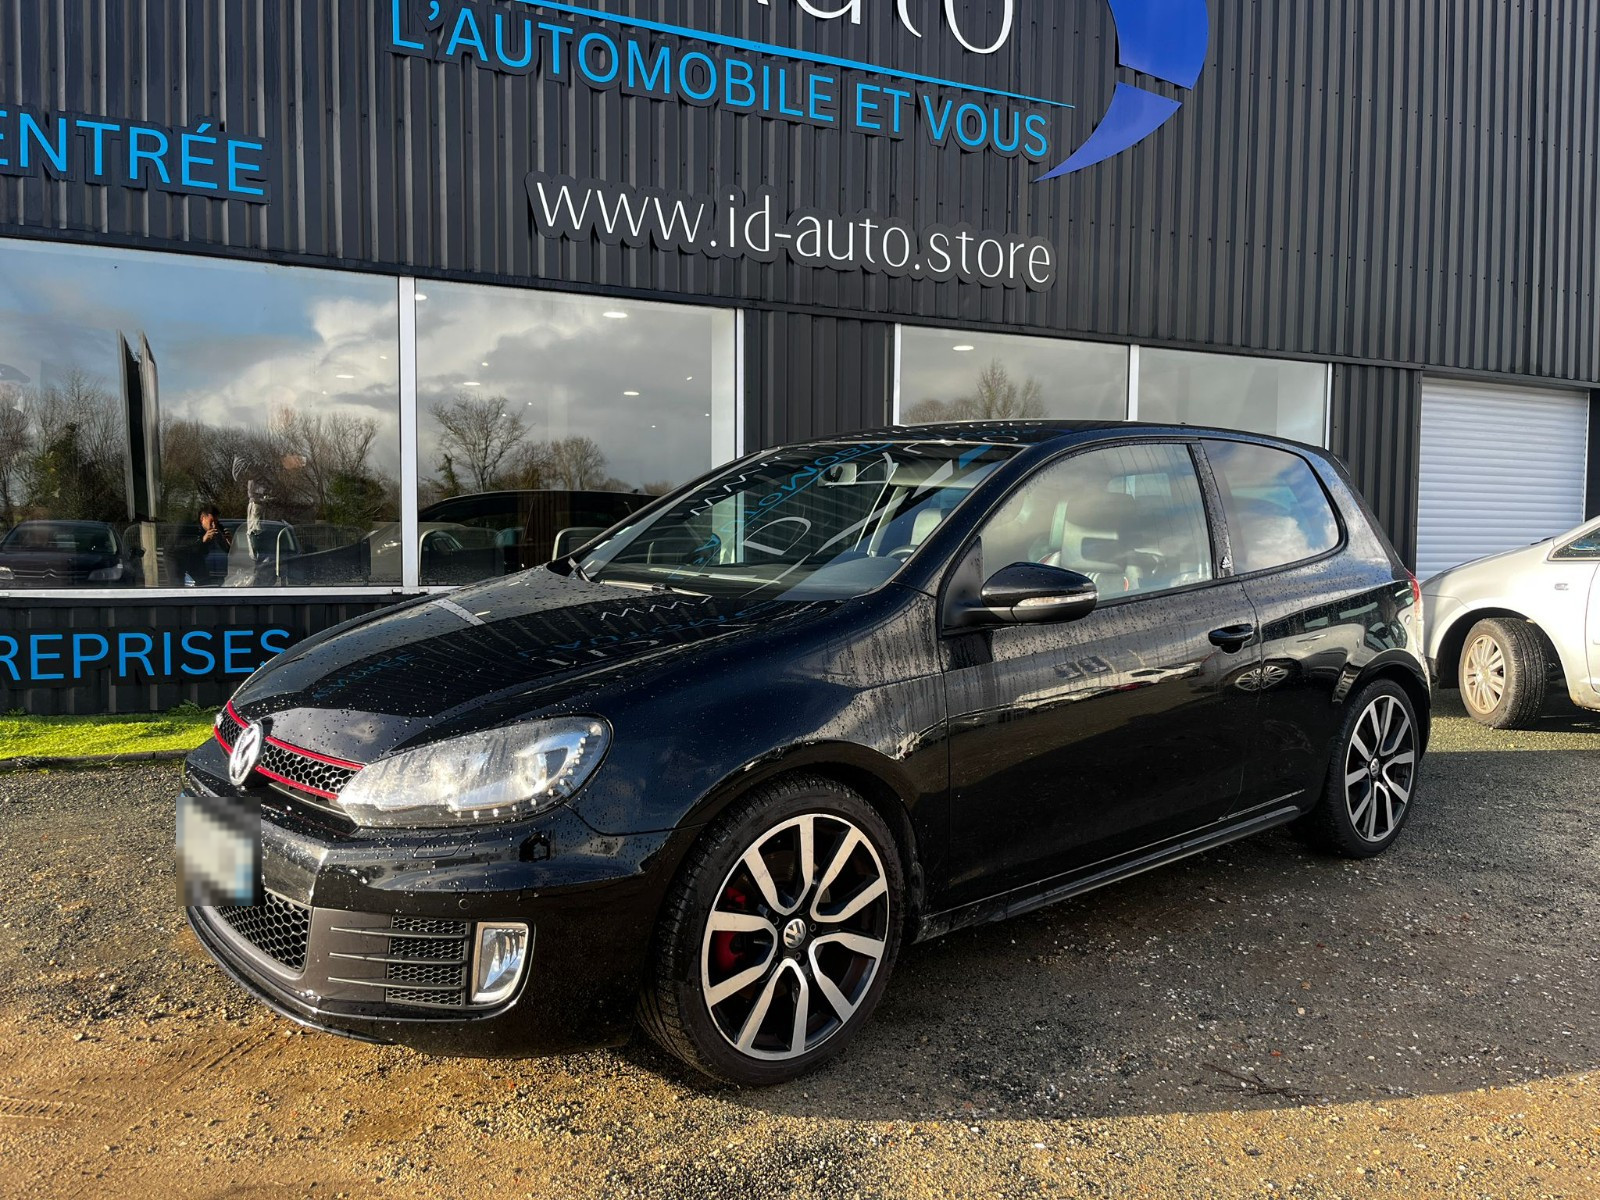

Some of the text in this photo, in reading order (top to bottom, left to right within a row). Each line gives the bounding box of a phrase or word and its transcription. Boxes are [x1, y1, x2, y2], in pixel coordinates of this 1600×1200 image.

[0, 110, 264, 196] NTRÉE
[857, 84, 911, 133] ET
[924, 96, 1047, 157] VOUS
[537, 182, 1050, 284] www.id-auto.store
